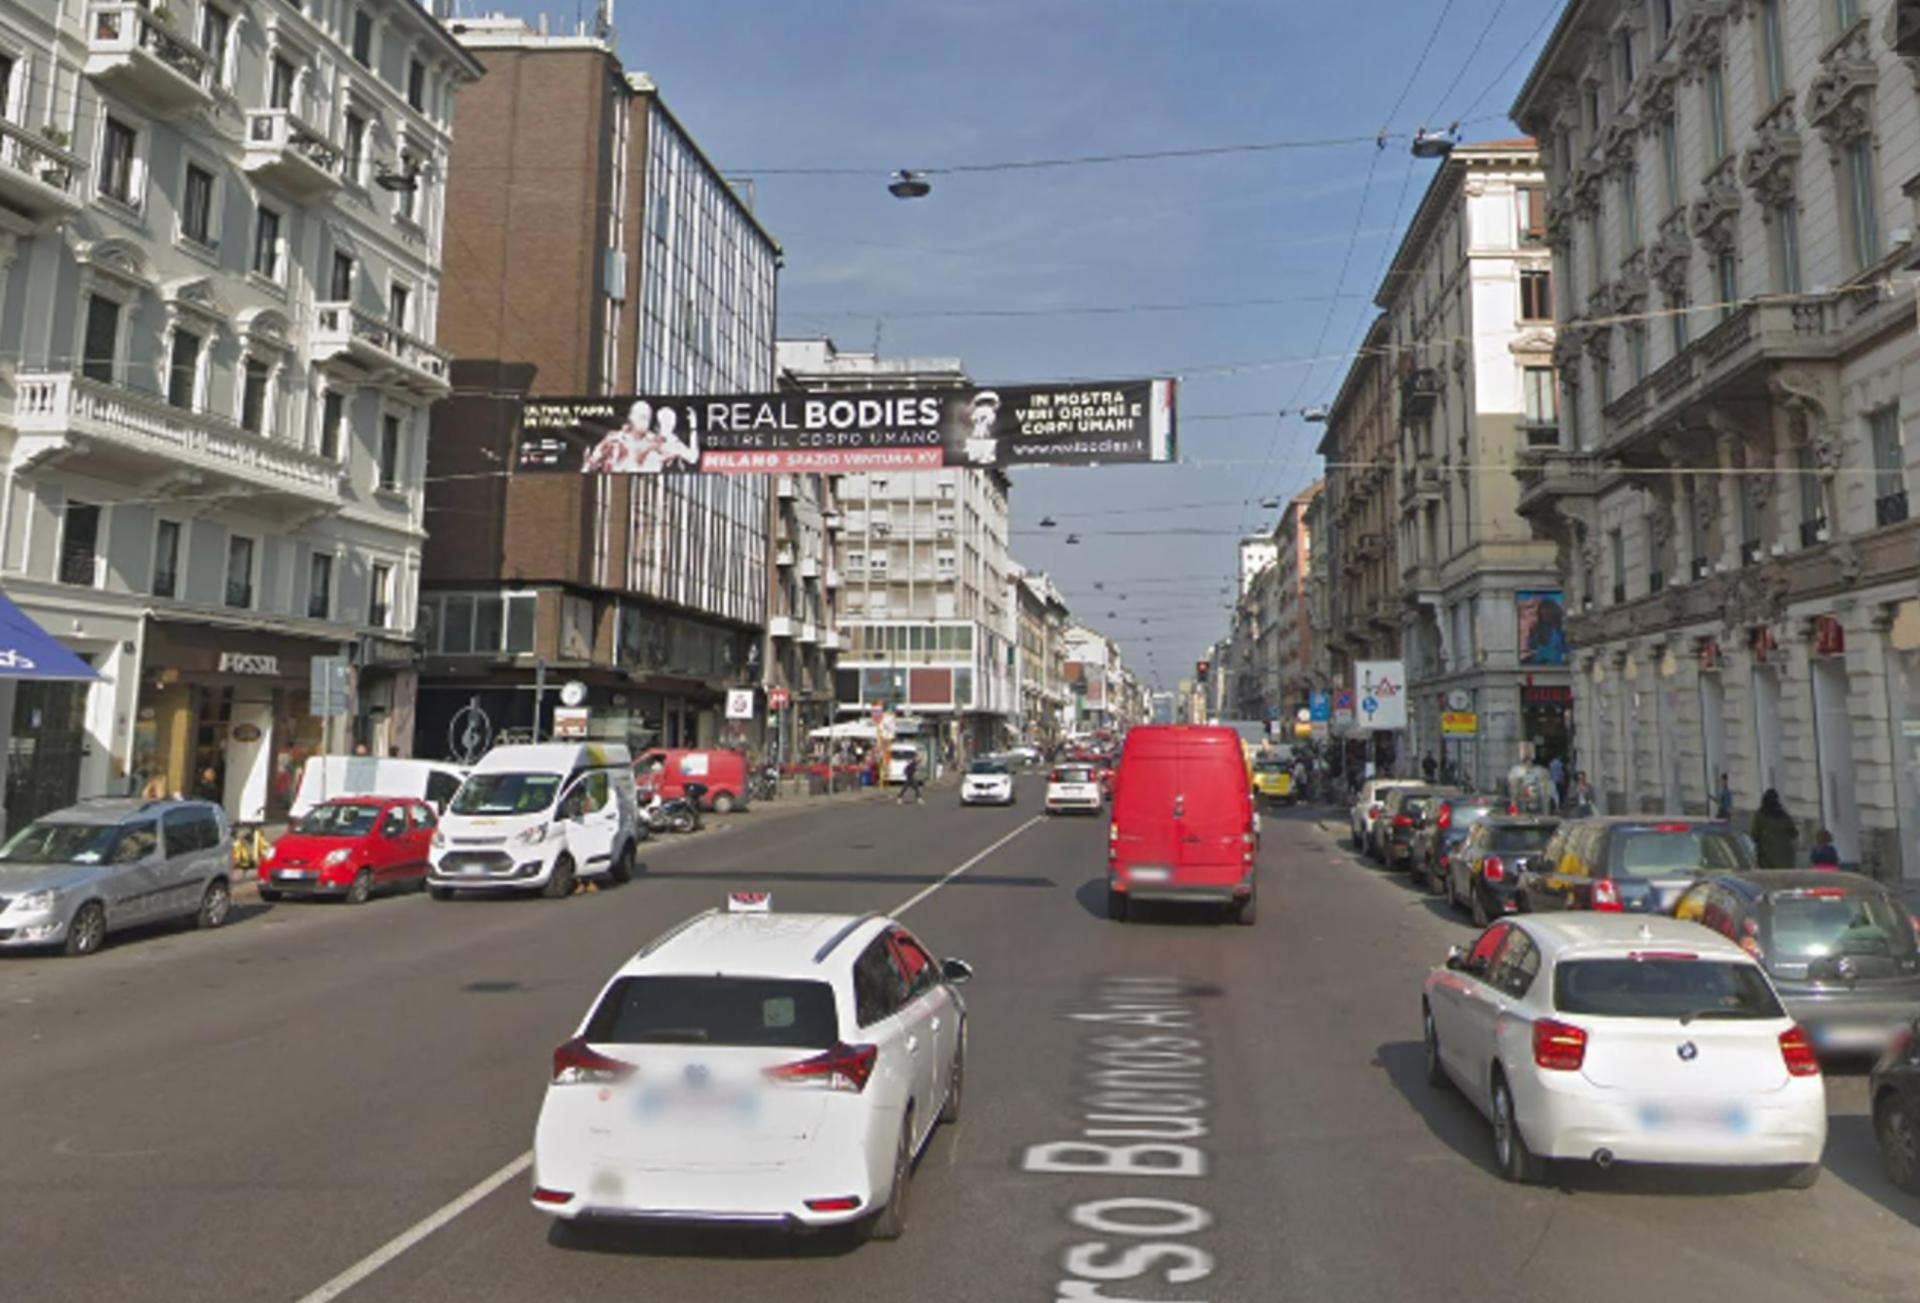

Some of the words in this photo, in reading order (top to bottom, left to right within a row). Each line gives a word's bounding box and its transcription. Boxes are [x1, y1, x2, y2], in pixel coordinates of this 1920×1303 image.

[1030, 394, 1050, 407] IN
[1053, 391, 1125, 406] MOSTRA
[706, 401, 799, 431] REAL
[804, 397, 941, 429] BODIES
[1014, 408, 1054, 421] VERI
[1059, 405, 1126, 420] ORGANI
[1131, 403, 1142, 417] E
[1021, 421, 1073, 435] CORPI
[1078, 418, 1134, 433] UMANI
[706, 434, 766, 447] OLTRE
[772, 434, 789, 446] IL
[798, 432, 863, 446] CORPO
[869, 430, 940, 445] UMANO
[704, 453, 779, 467] MILANO
[219, 651, 281, 676] FOSSIL
